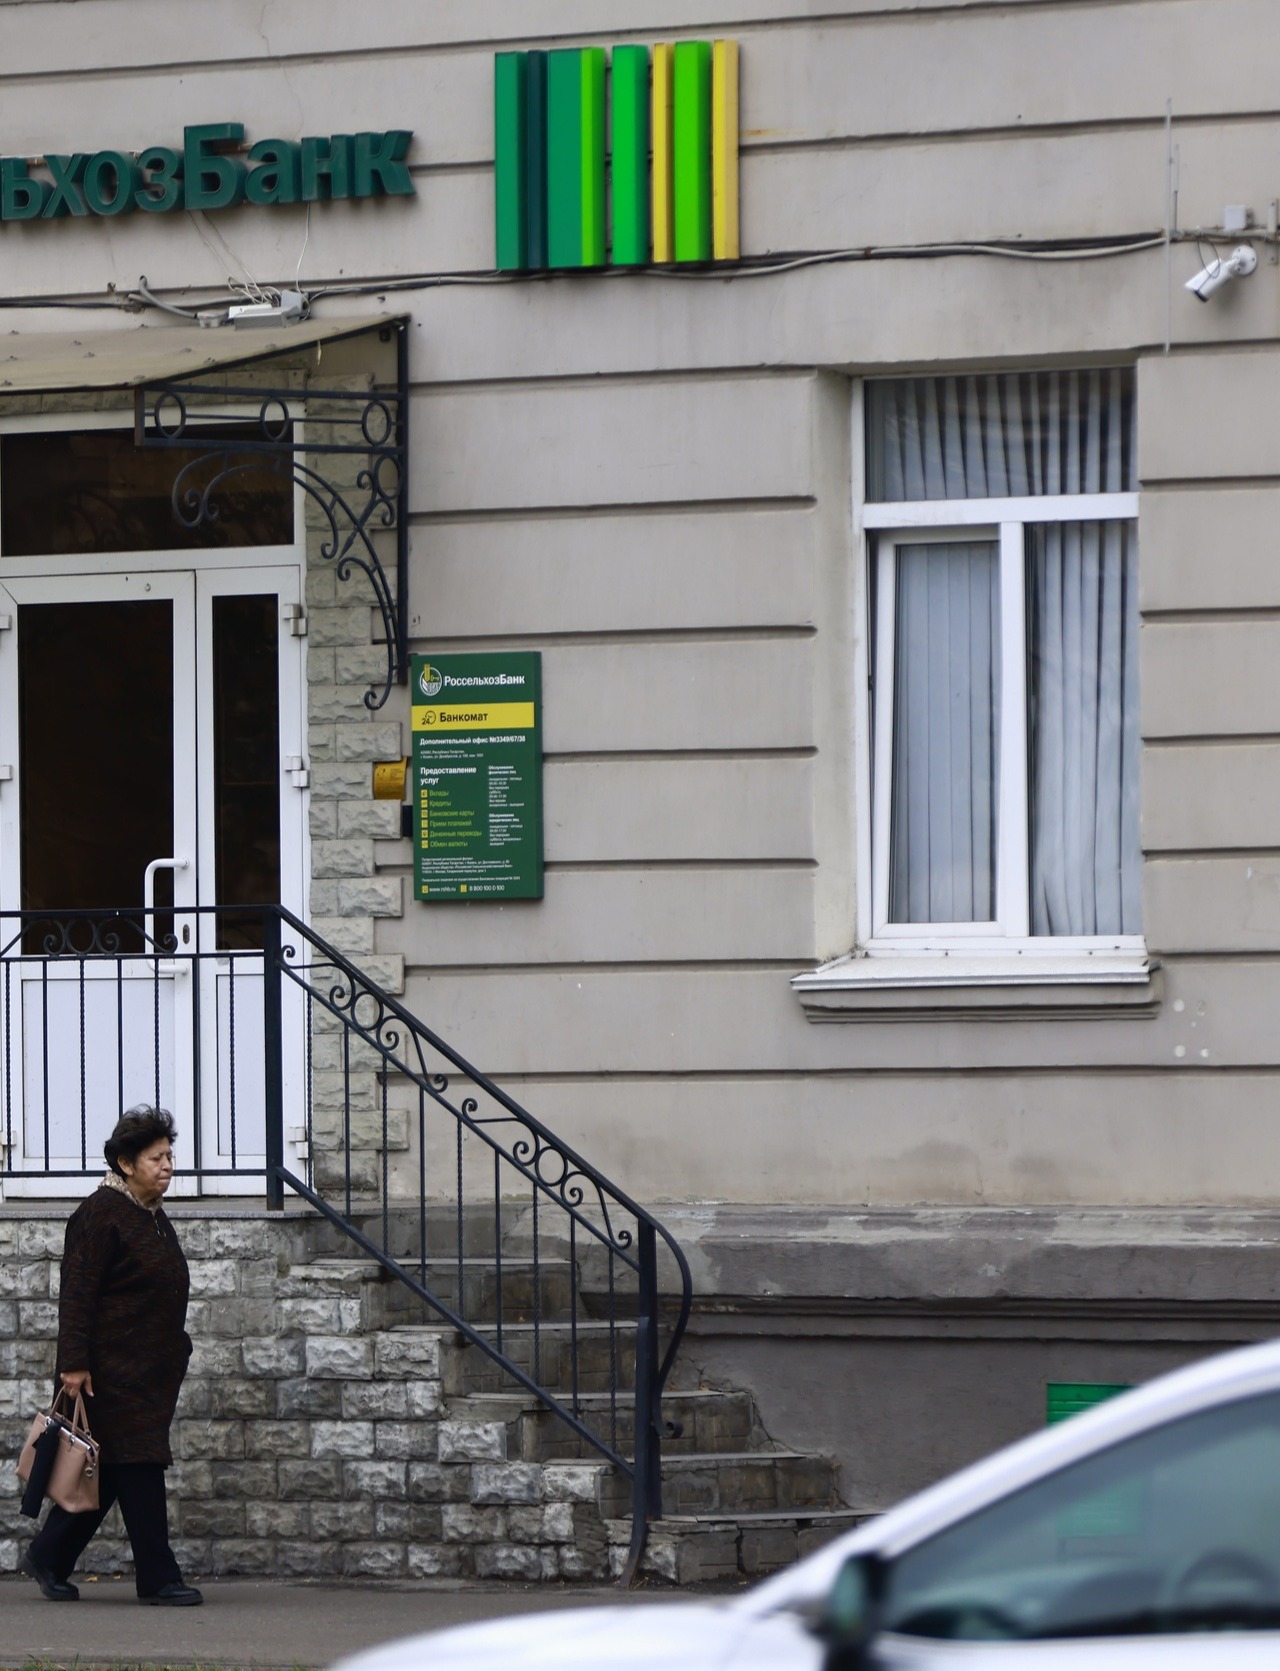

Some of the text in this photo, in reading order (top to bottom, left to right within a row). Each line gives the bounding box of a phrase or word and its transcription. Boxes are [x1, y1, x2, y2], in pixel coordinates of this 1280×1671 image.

[444, 674, 525, 686] РоссельхозБанк
[440, 712, 488, 722] Банкомат
[419, 737, 471, 745] Дополнительный
[473, 736, 488, 744] офис
[420, 767, 476, 776] Предоставление
[420, 778, 439, 786] услуг
